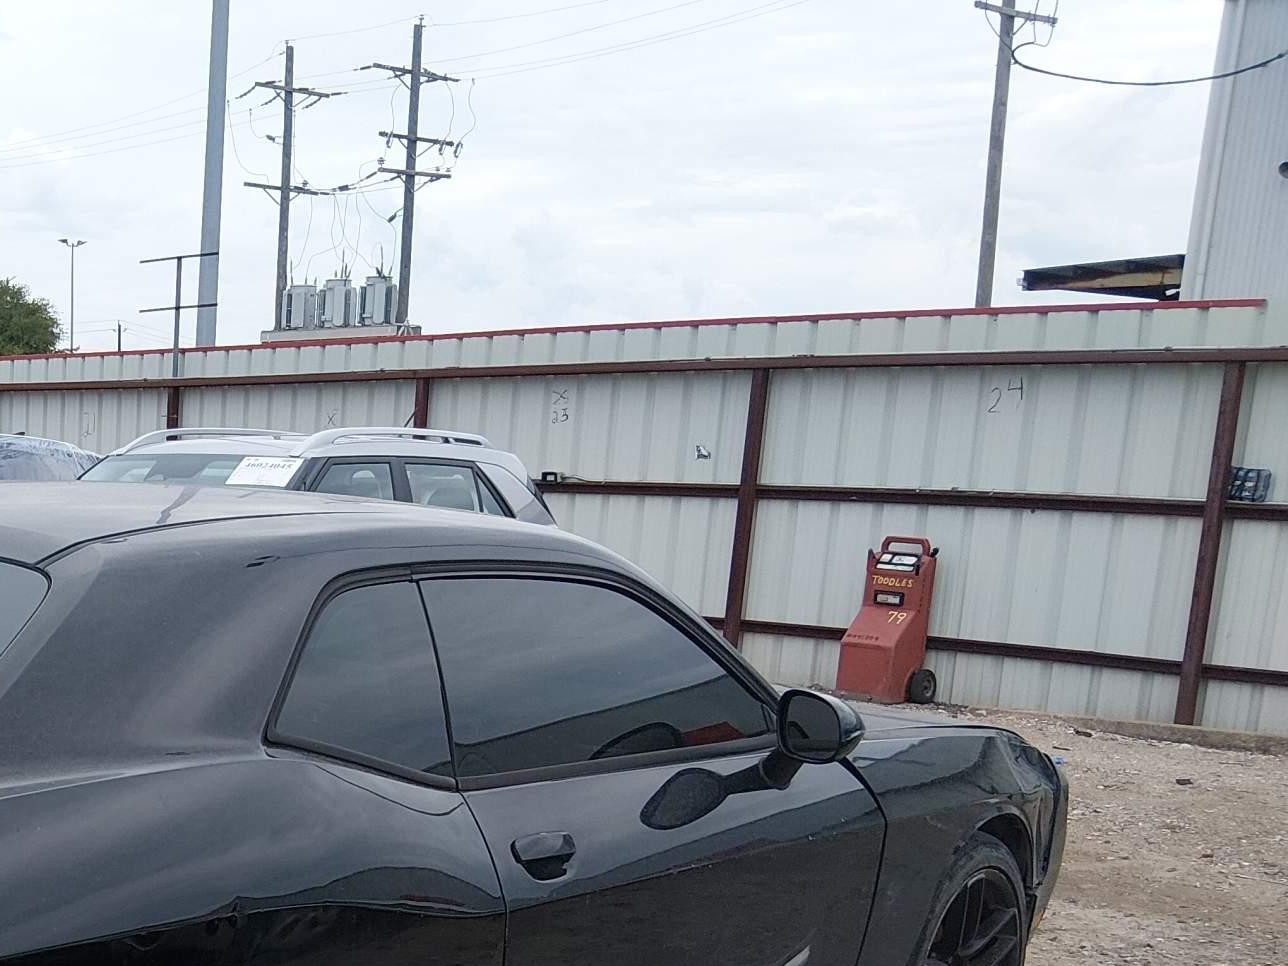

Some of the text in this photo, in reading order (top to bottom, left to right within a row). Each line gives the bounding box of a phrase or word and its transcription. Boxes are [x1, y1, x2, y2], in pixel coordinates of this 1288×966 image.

[987, 376, 1023, 413] 24
[872, 575, 913, 587] TOODLES
[887, 610, 907, 625] 79
